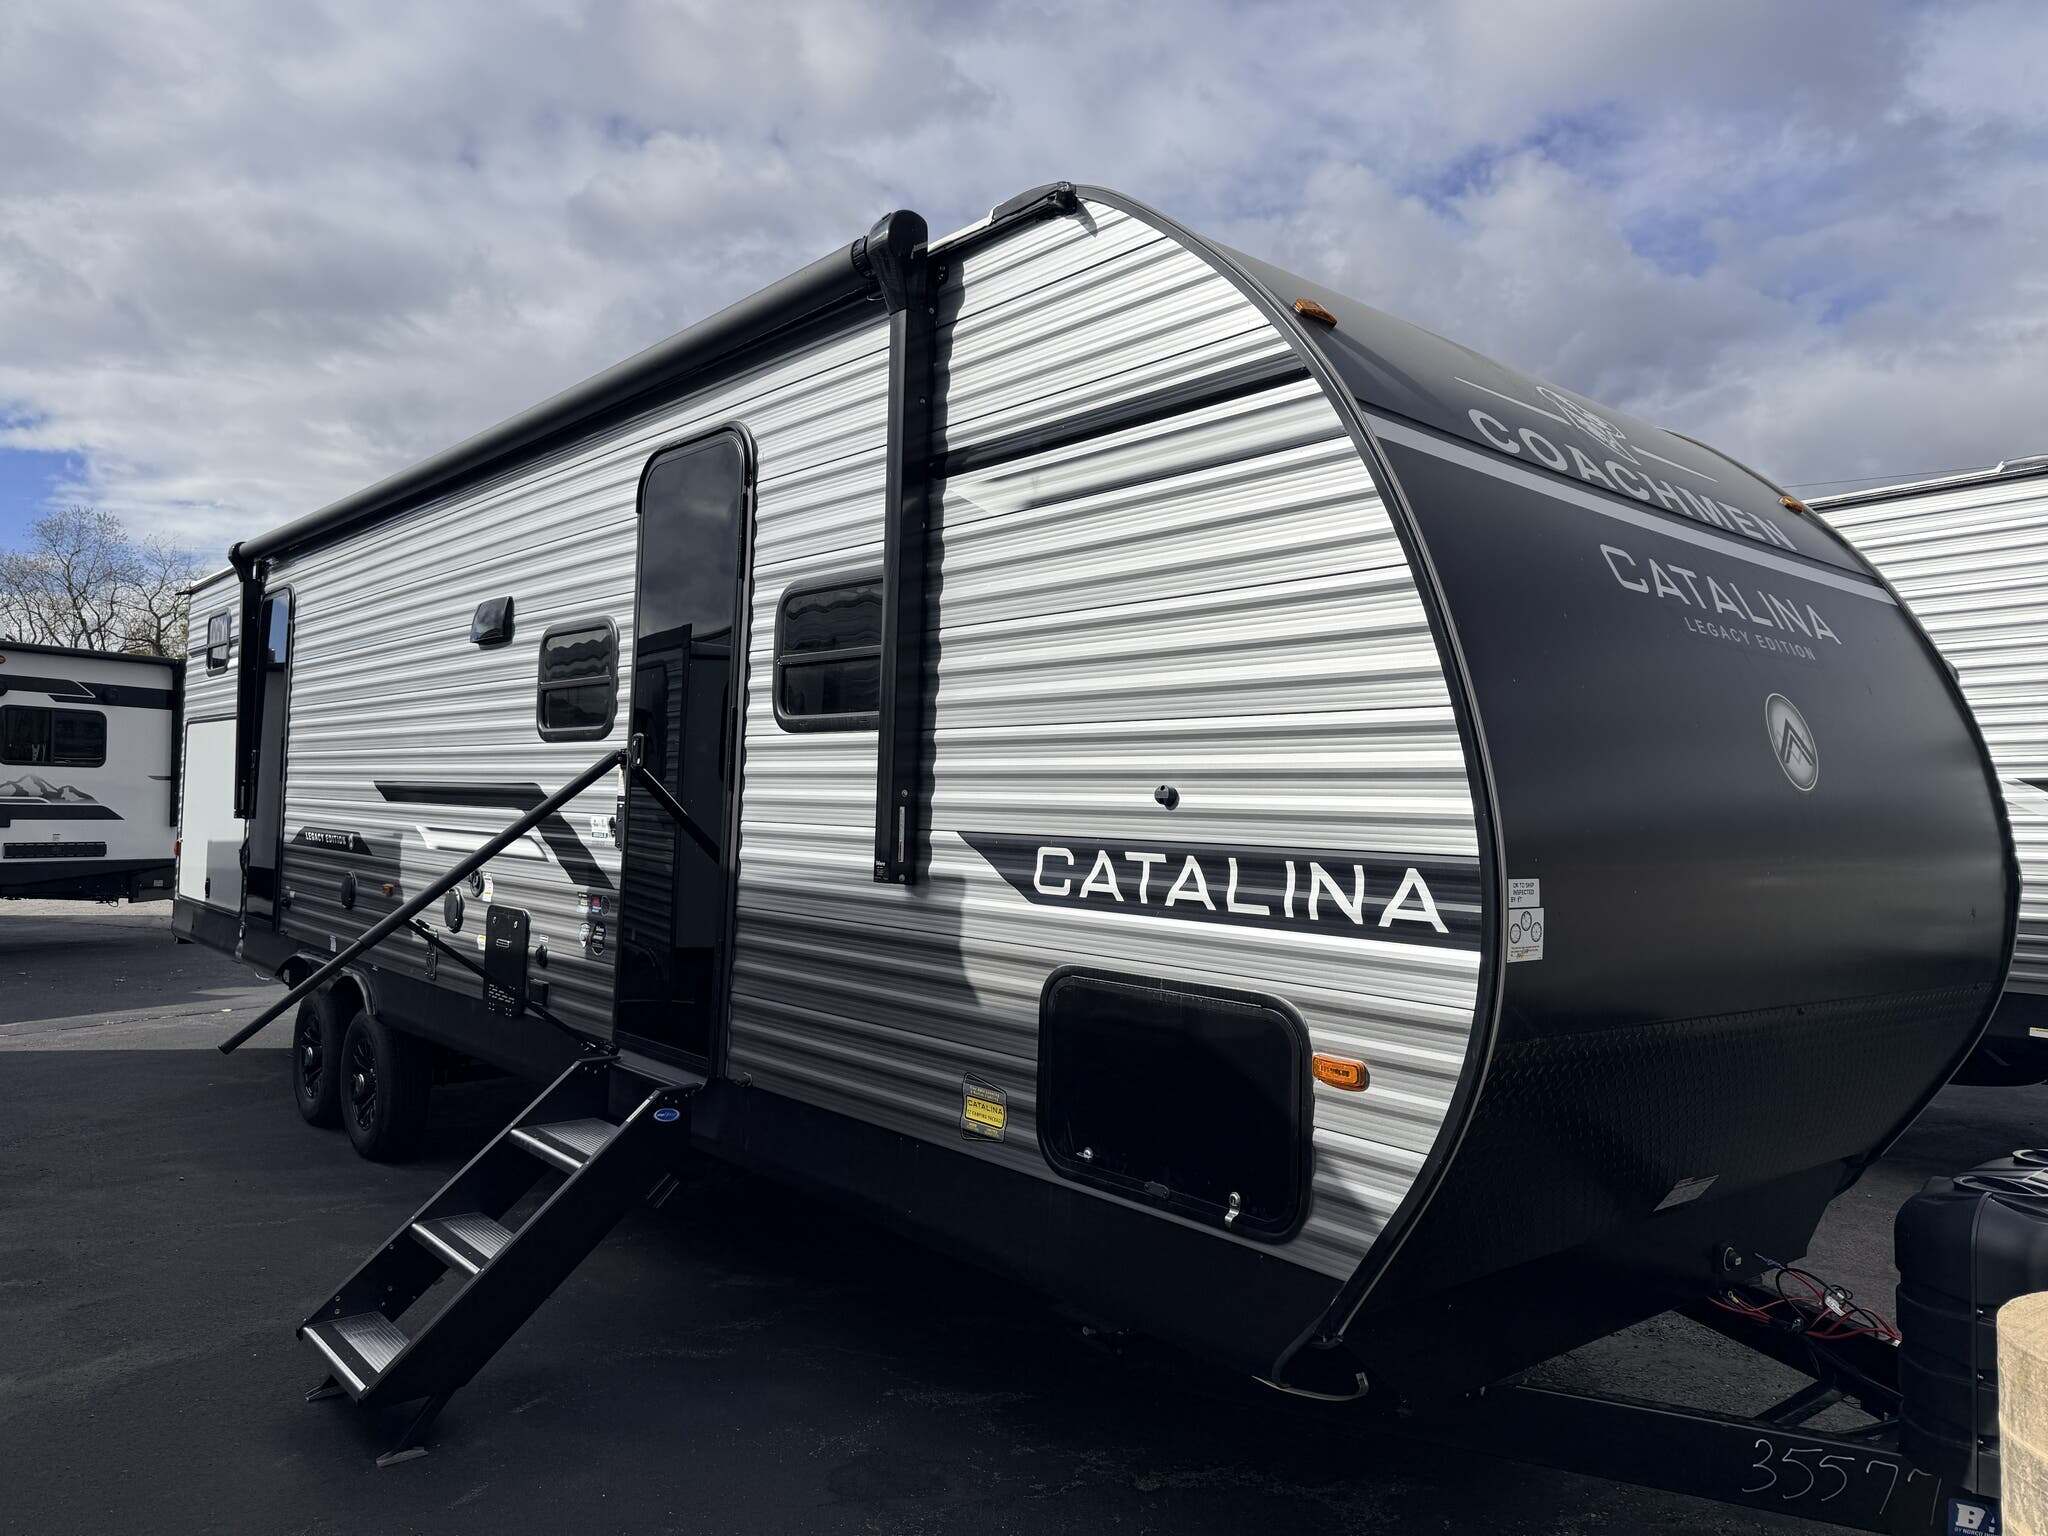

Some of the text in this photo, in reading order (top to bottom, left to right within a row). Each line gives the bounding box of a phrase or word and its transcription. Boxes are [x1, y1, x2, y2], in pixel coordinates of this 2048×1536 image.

[1468, 409, 1798, 551] COACHMEN
[1600, 544, 1842, 645] CATALINA
[1684, 616, 1816, 661] LEGACY EDITION
[305, 832, 347, 844] LEGACY EDITION
[1033, 846, 1449, 934] CATALINA
[967, 1099, 1003, 1115] CATALINA
[1742, 1438, 1941, 1527] 35577
